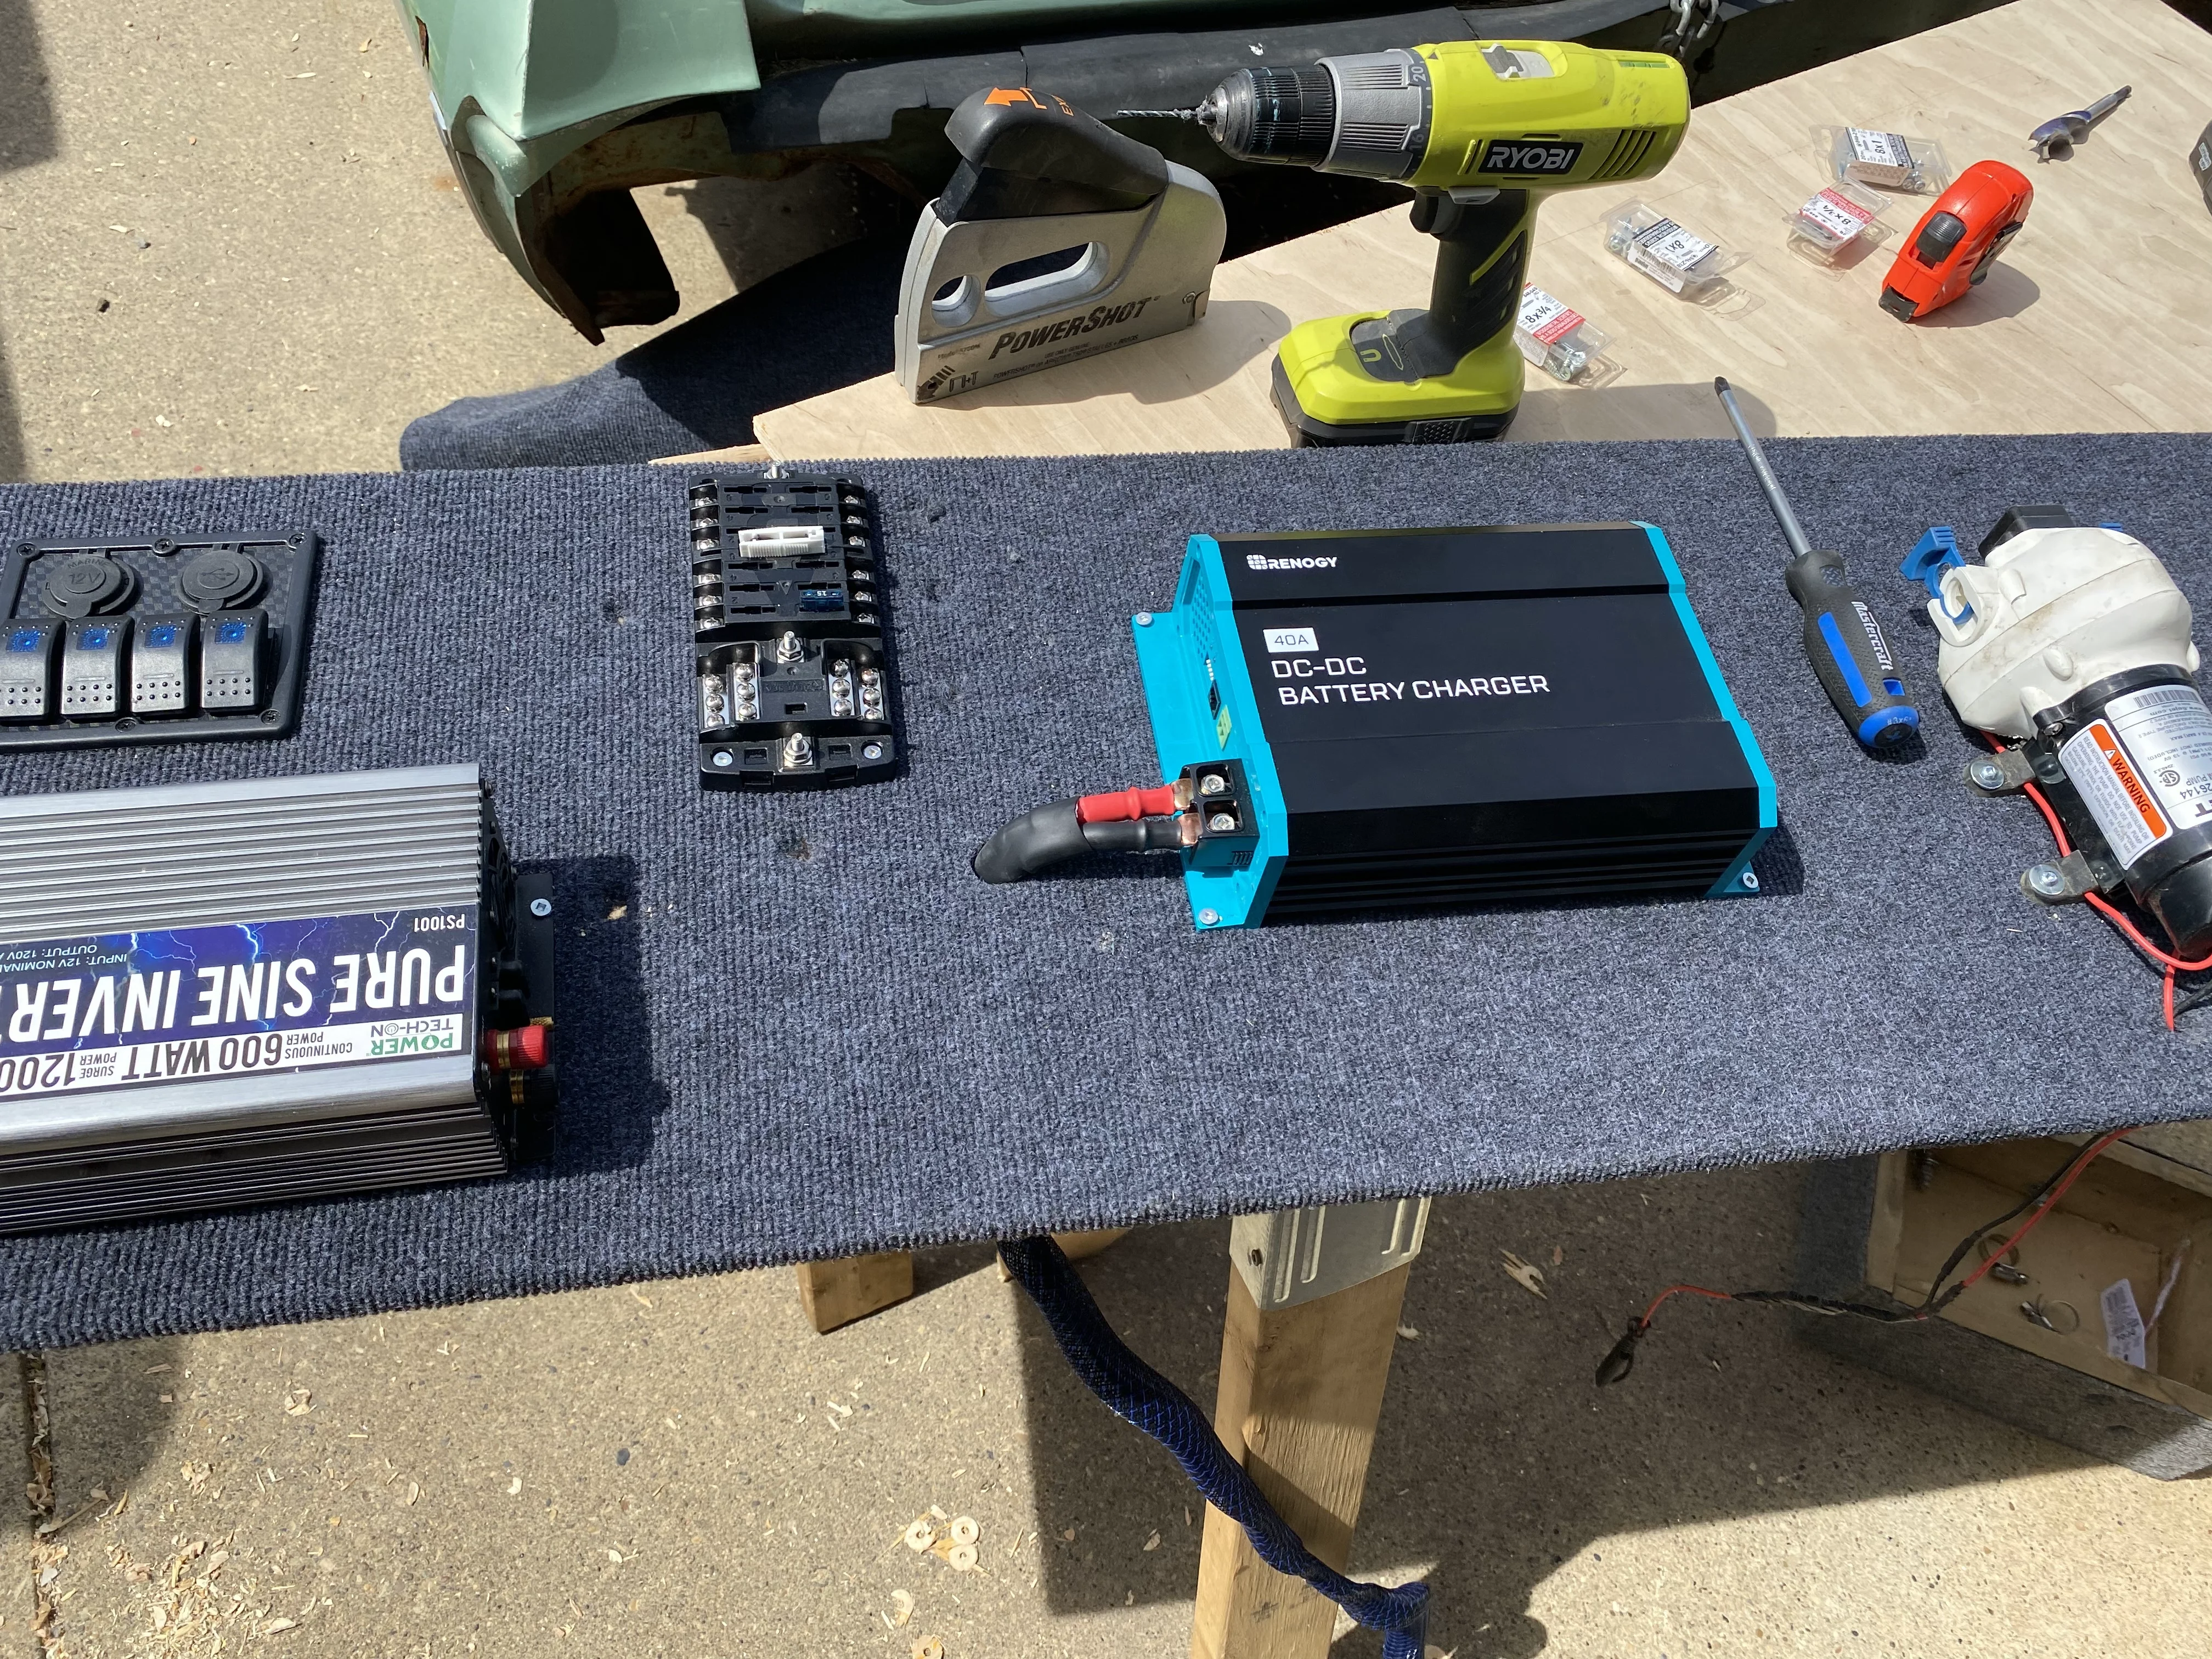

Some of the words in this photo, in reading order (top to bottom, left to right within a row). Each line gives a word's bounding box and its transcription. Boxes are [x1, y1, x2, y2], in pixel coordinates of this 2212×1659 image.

[1411, 66, 1426, 82] 20
[1410, 134, 1424, 150] 16
[1487, 147, 1575, 169] RYOBI
[68, 558, 111, 568] MARINE
[1267, 557, 1338, 569] RENOGY
[69, 573, 101, 584] 12V
[1274, 635, 1309, 646] 40A
[1271, 657, 1367, 678] DC-DC
[1278, 681, 1404, 706] BATTERY
[1412, 675, 1550, 699] CHARGER
[2083, 736, 2093, 749] READ
[2089, 747, 2109, 776] INSTRUCTION
[2106, 774, 2121, 794] MANUAL
[2117, 793, 2131, 811] BEFORE
[2141, 831, 2149, 840] OR
[2111, 757, 2151, 814] WARNING
[2186, 774, 2208, 786] PUMP
[2076, 741, 2094, 765] OPERATING
[2091, 765, 2100, 775] THE
[2107, 791, 2115, 800] DO
[2112, 800, 2121, 811] NOT
[2119, 811, 2128, 821] USE
[2130, 830, 2142, 845] PUMP
[2084, 768, 2097, 785] PETROL
[2099, 792, 2111, 809] FLUIDS
[2108, 808, 2119, 821] WITH
[2112, 827, 2124, 843] DEATH
[2122, 843, 2131, 854] MAY
[415, 914, 465, 932] PS1001
[7, 950, 37, 960] 120V
[42, 945, 98, 958] OUTPUT:
[87, 953, 127, 966] INPUT:
[58, 956, 81, 968] 12V
[329, 945, 465, 1013] PURE
[191, 958, 316, 1026] SINE
[0, 970, 181, 1042] INVER
[286, 1031, 324, 1045] POWER
[371, 1032, 453, 1056] POWER
[80, 1052, 117, 1065] POWER
[219, 1033, 283, 1070] 600
[285, 1042, 353, 1059] CONTINUOUS
[121, 1040, 210, 1081] WATT
[79, 1065, 114, 1079] SURGE
